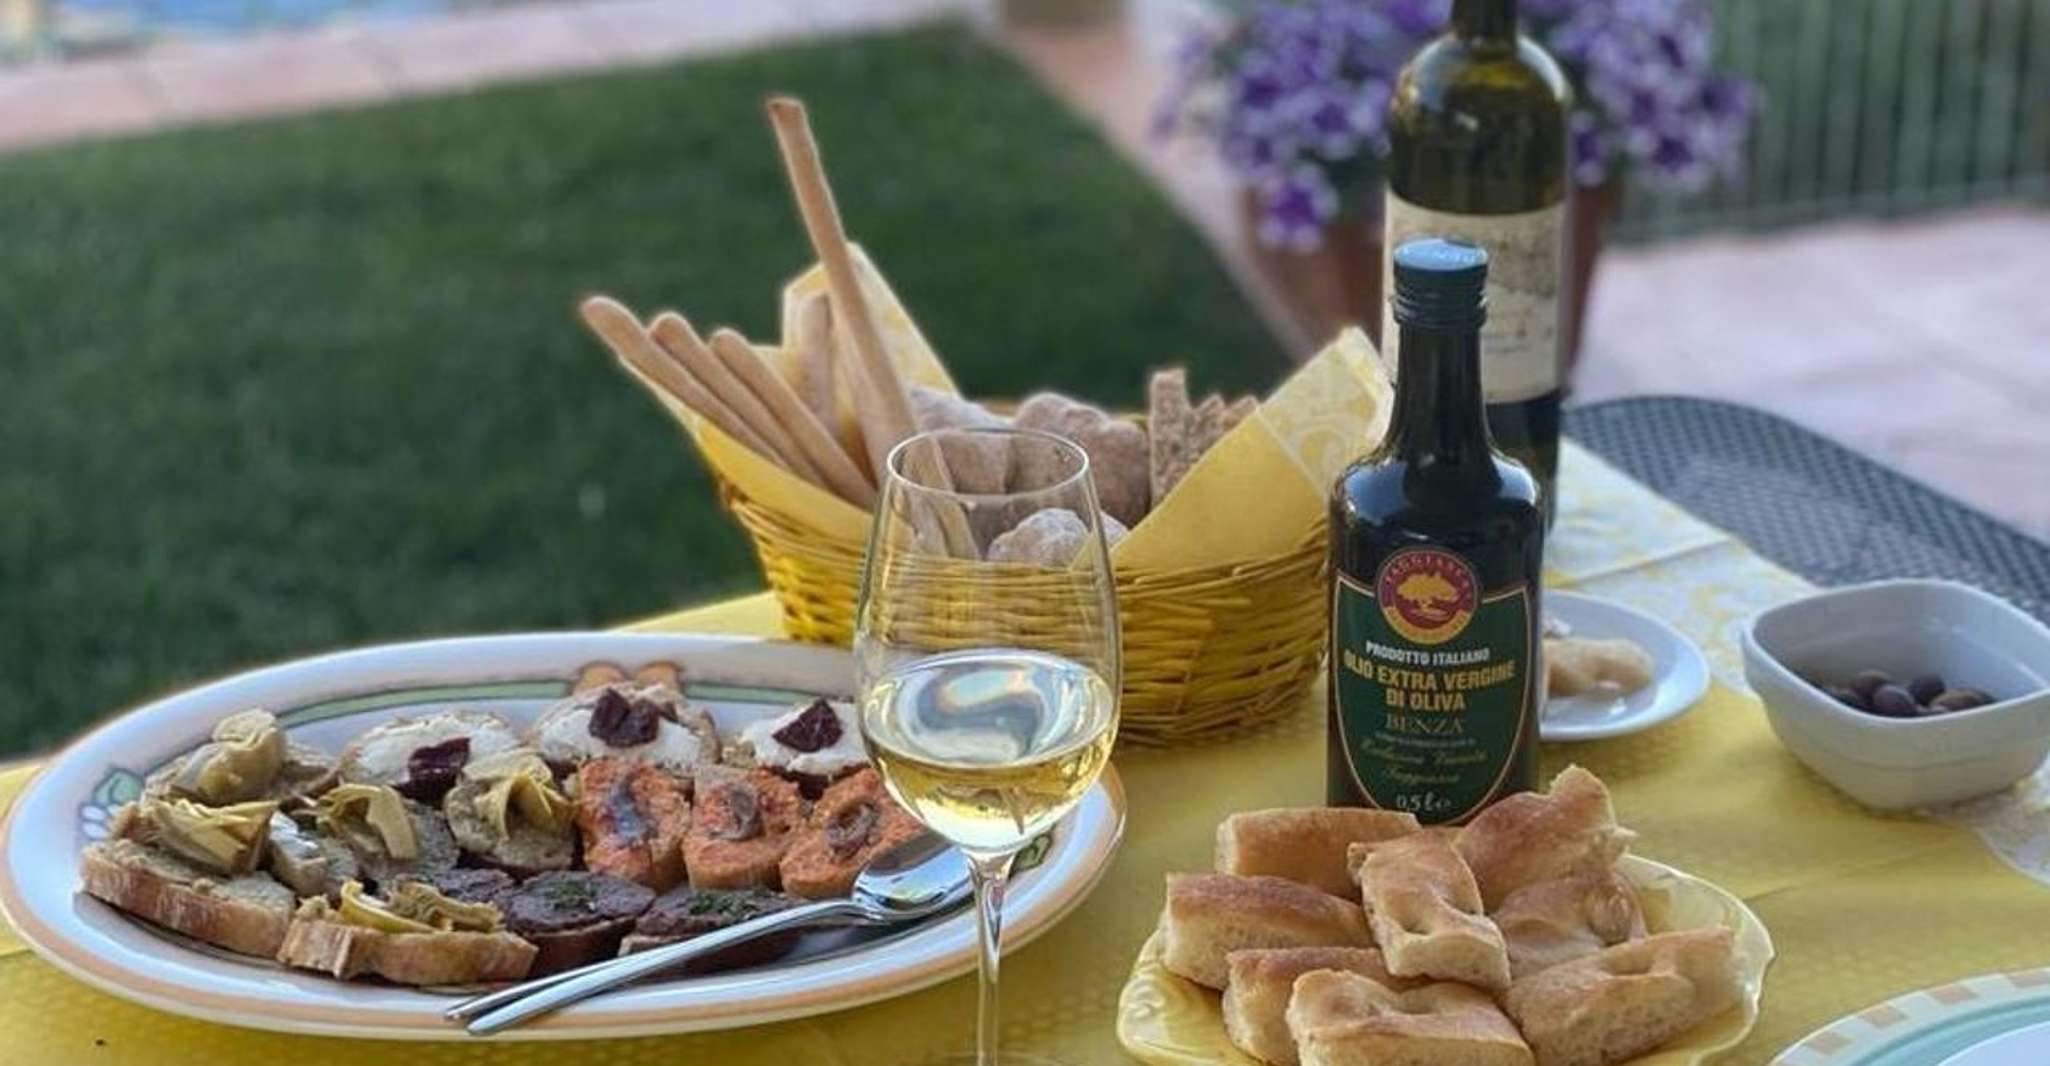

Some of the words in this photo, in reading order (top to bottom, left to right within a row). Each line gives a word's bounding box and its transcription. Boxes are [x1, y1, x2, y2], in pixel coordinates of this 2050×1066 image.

[1365, 640, 1430, 665] PRODOTTO
[1433, 648, 1490, 666] ITALIANO
[1343, 650, 1373, 679] OLIO
[1376, 665, 1438, 690] EXTRA
[1443, 659, 1516, 691] VERGINE
[1385, 688, 1404, 707] DI
[1410, 691, 1467, 711] OLIVA
